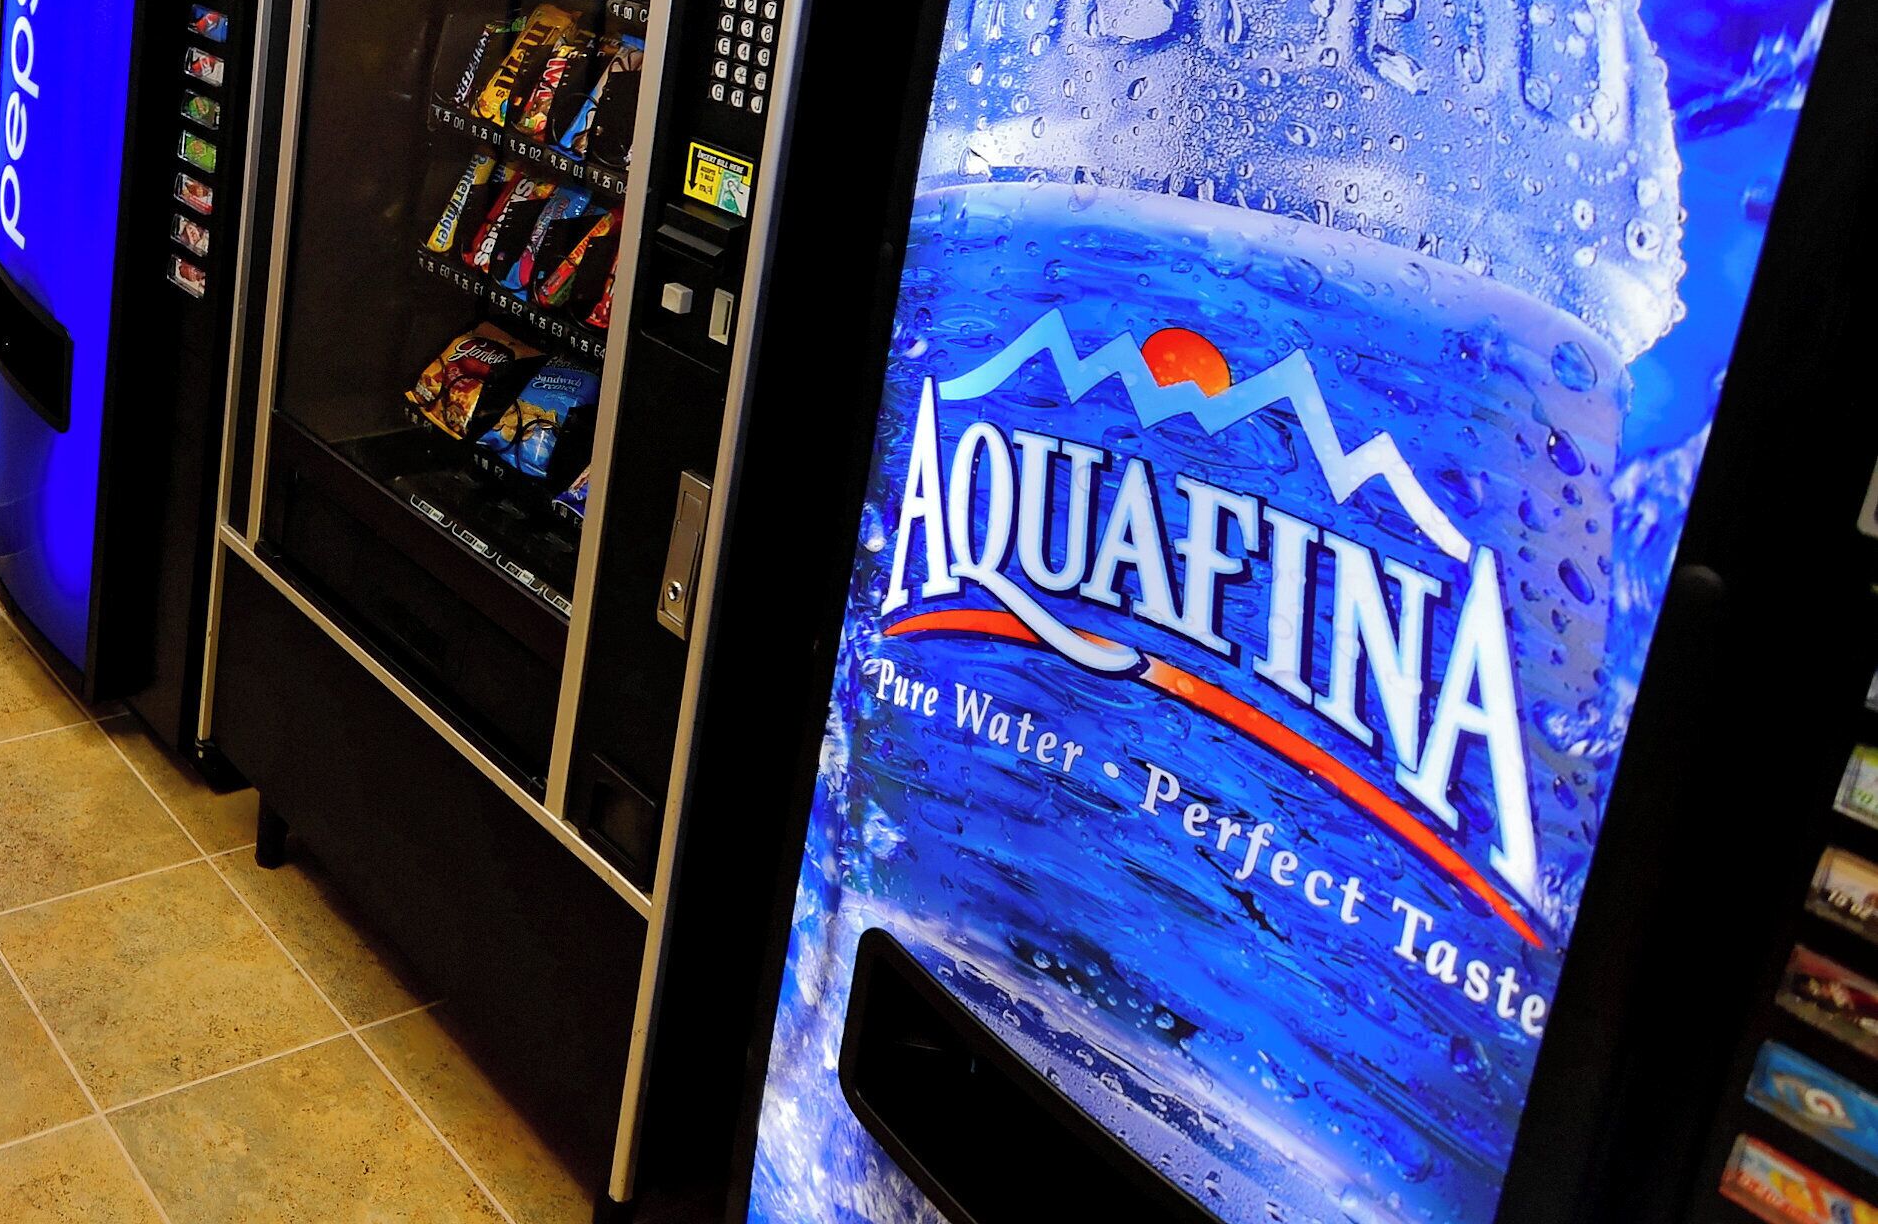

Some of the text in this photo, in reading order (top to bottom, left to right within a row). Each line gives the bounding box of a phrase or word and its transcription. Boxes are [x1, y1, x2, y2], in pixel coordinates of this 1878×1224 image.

[639, 8, 649, 23] C
[697, 149, 745, 174] INSERT BILL HERE
[473, 282, 484, 296] E1
[511, 301, 523, 317] E2
[551, 322, 563, 338] E3
[535, 374, 582, 388] Sandwich
[881, 376, 1544, 909] AQUAFINA
[875, 657, 1550, 1039] Pure Water Perfect Taste
